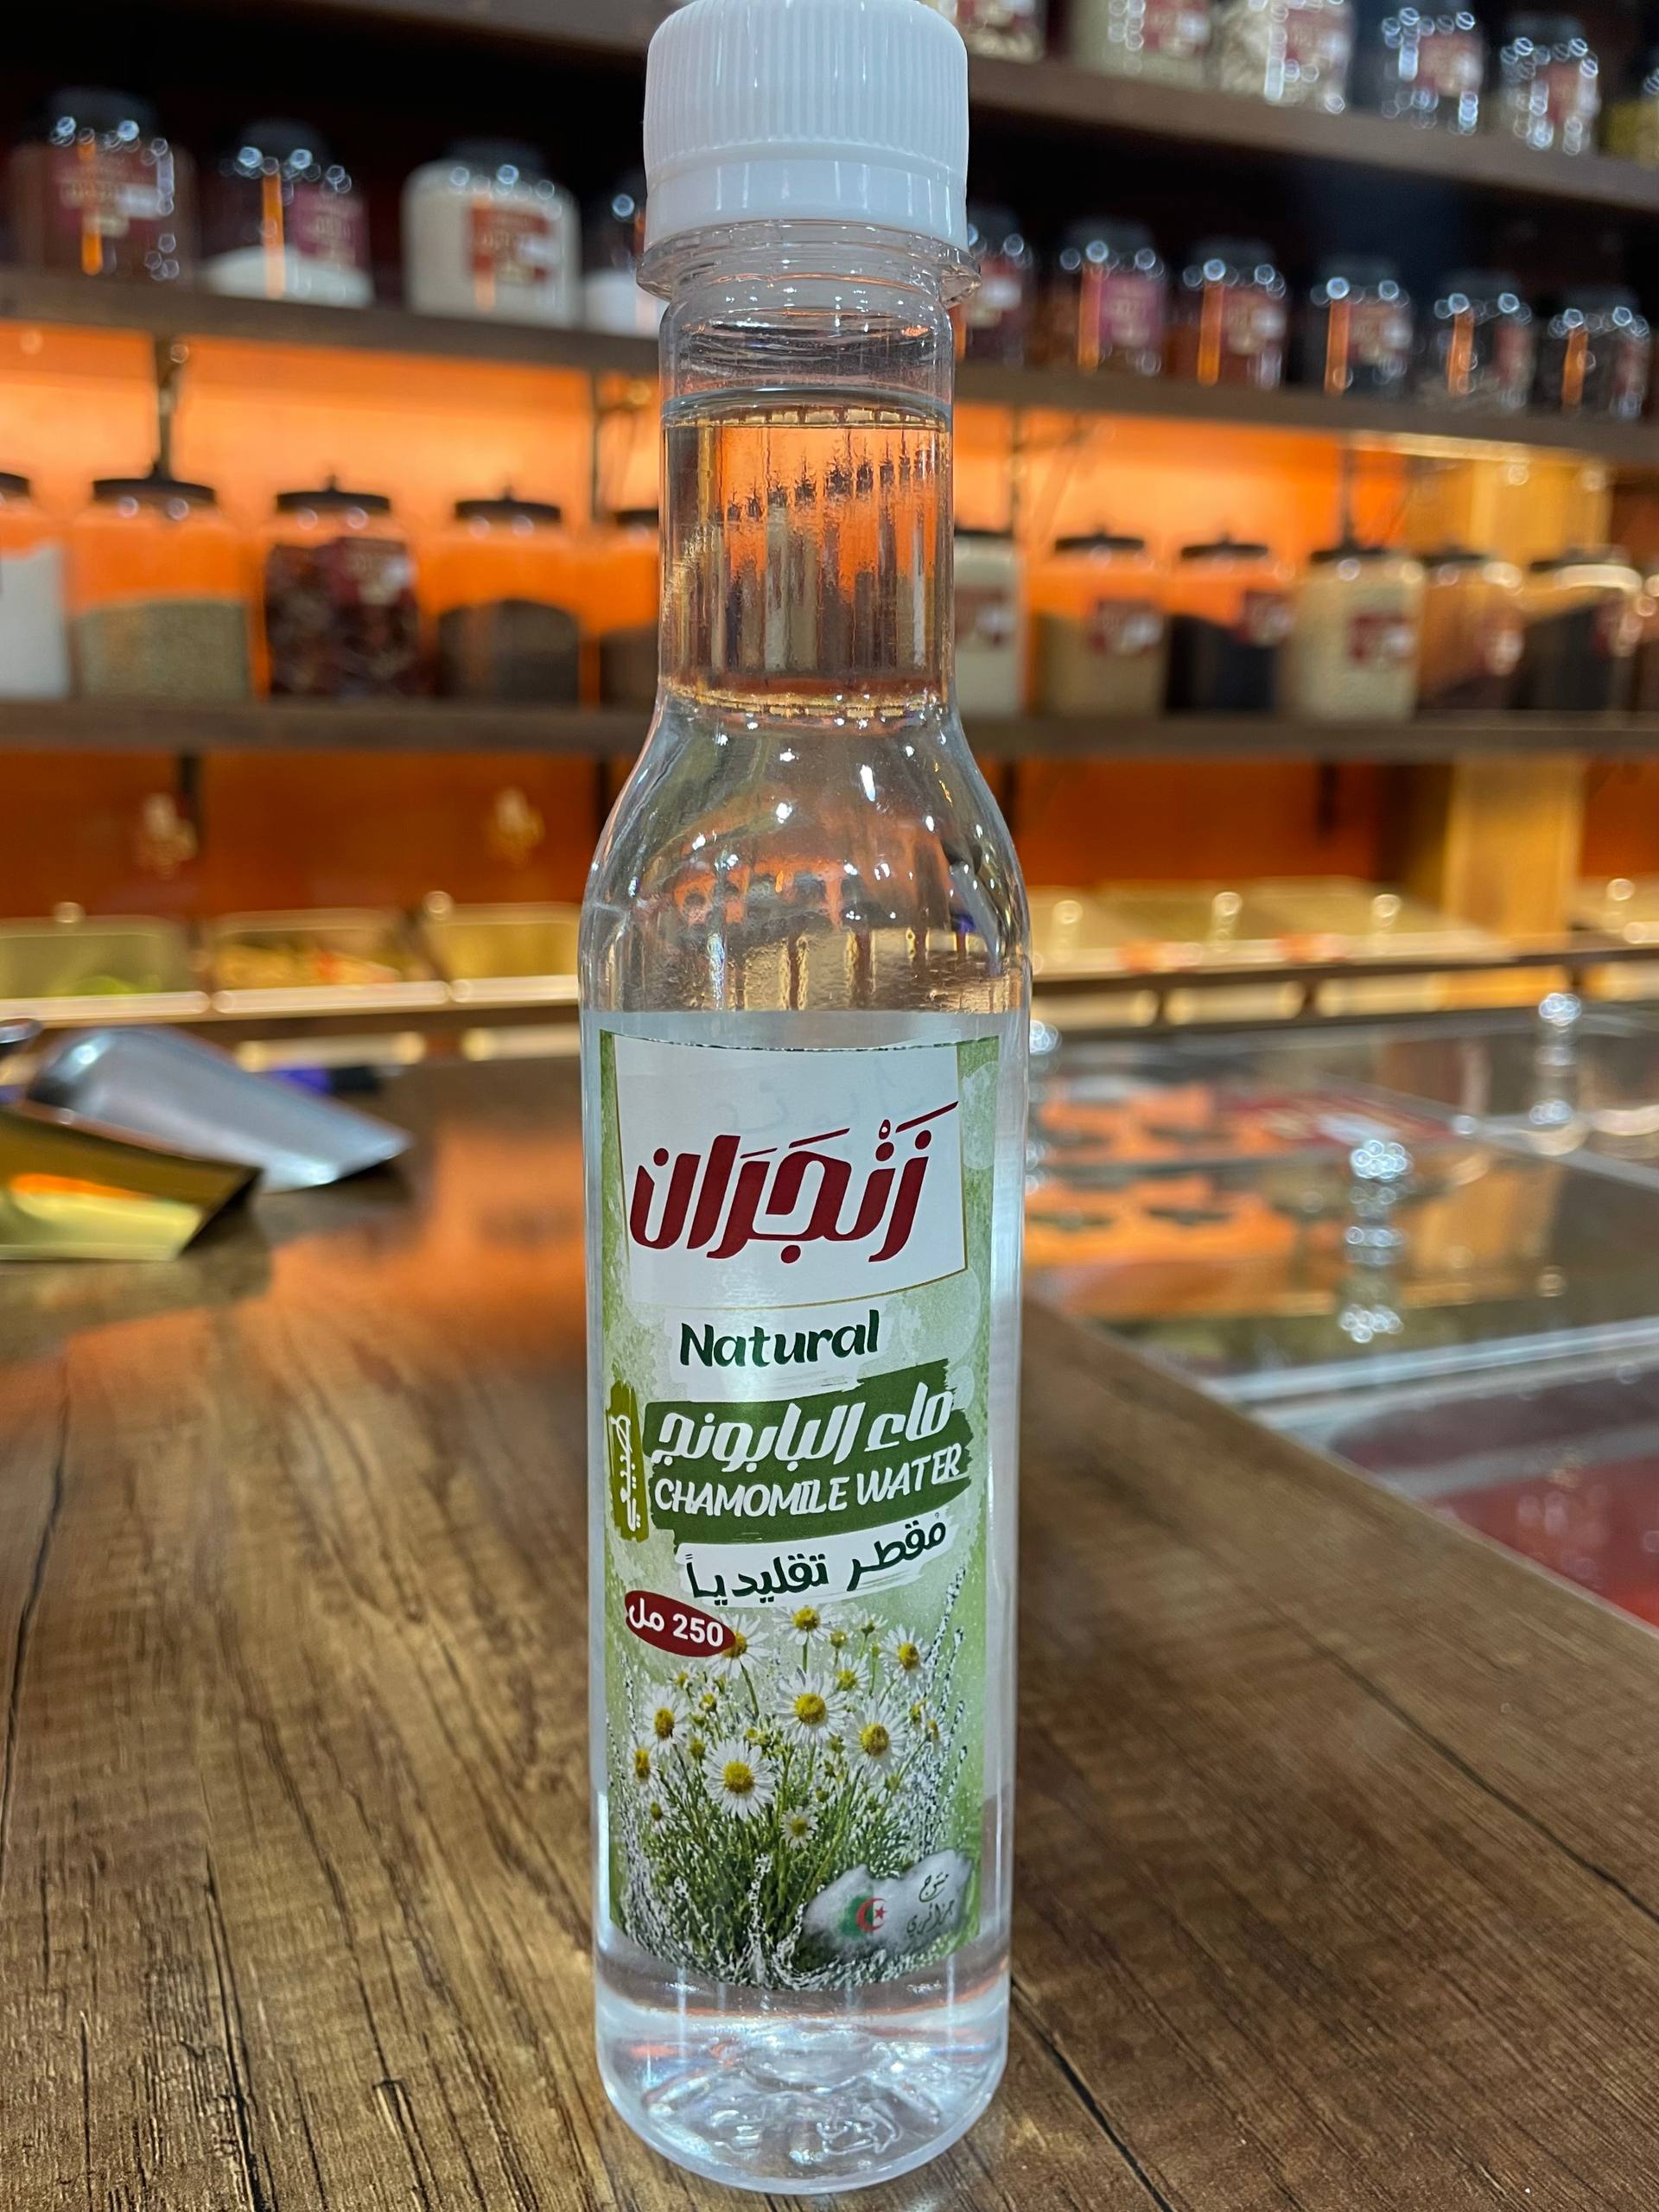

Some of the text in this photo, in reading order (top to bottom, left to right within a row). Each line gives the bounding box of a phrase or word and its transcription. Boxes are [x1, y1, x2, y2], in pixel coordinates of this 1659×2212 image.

[680, 1310, 880, 1368] Natural
[651, 1382, 953, 1472] ماء البابونج
[610, 1414, 641, 1532] طبيعي
[654, 1442, 962, 1517] CHAMOMILE WATER
[628, 1598, 724, 1647] 250 مل
